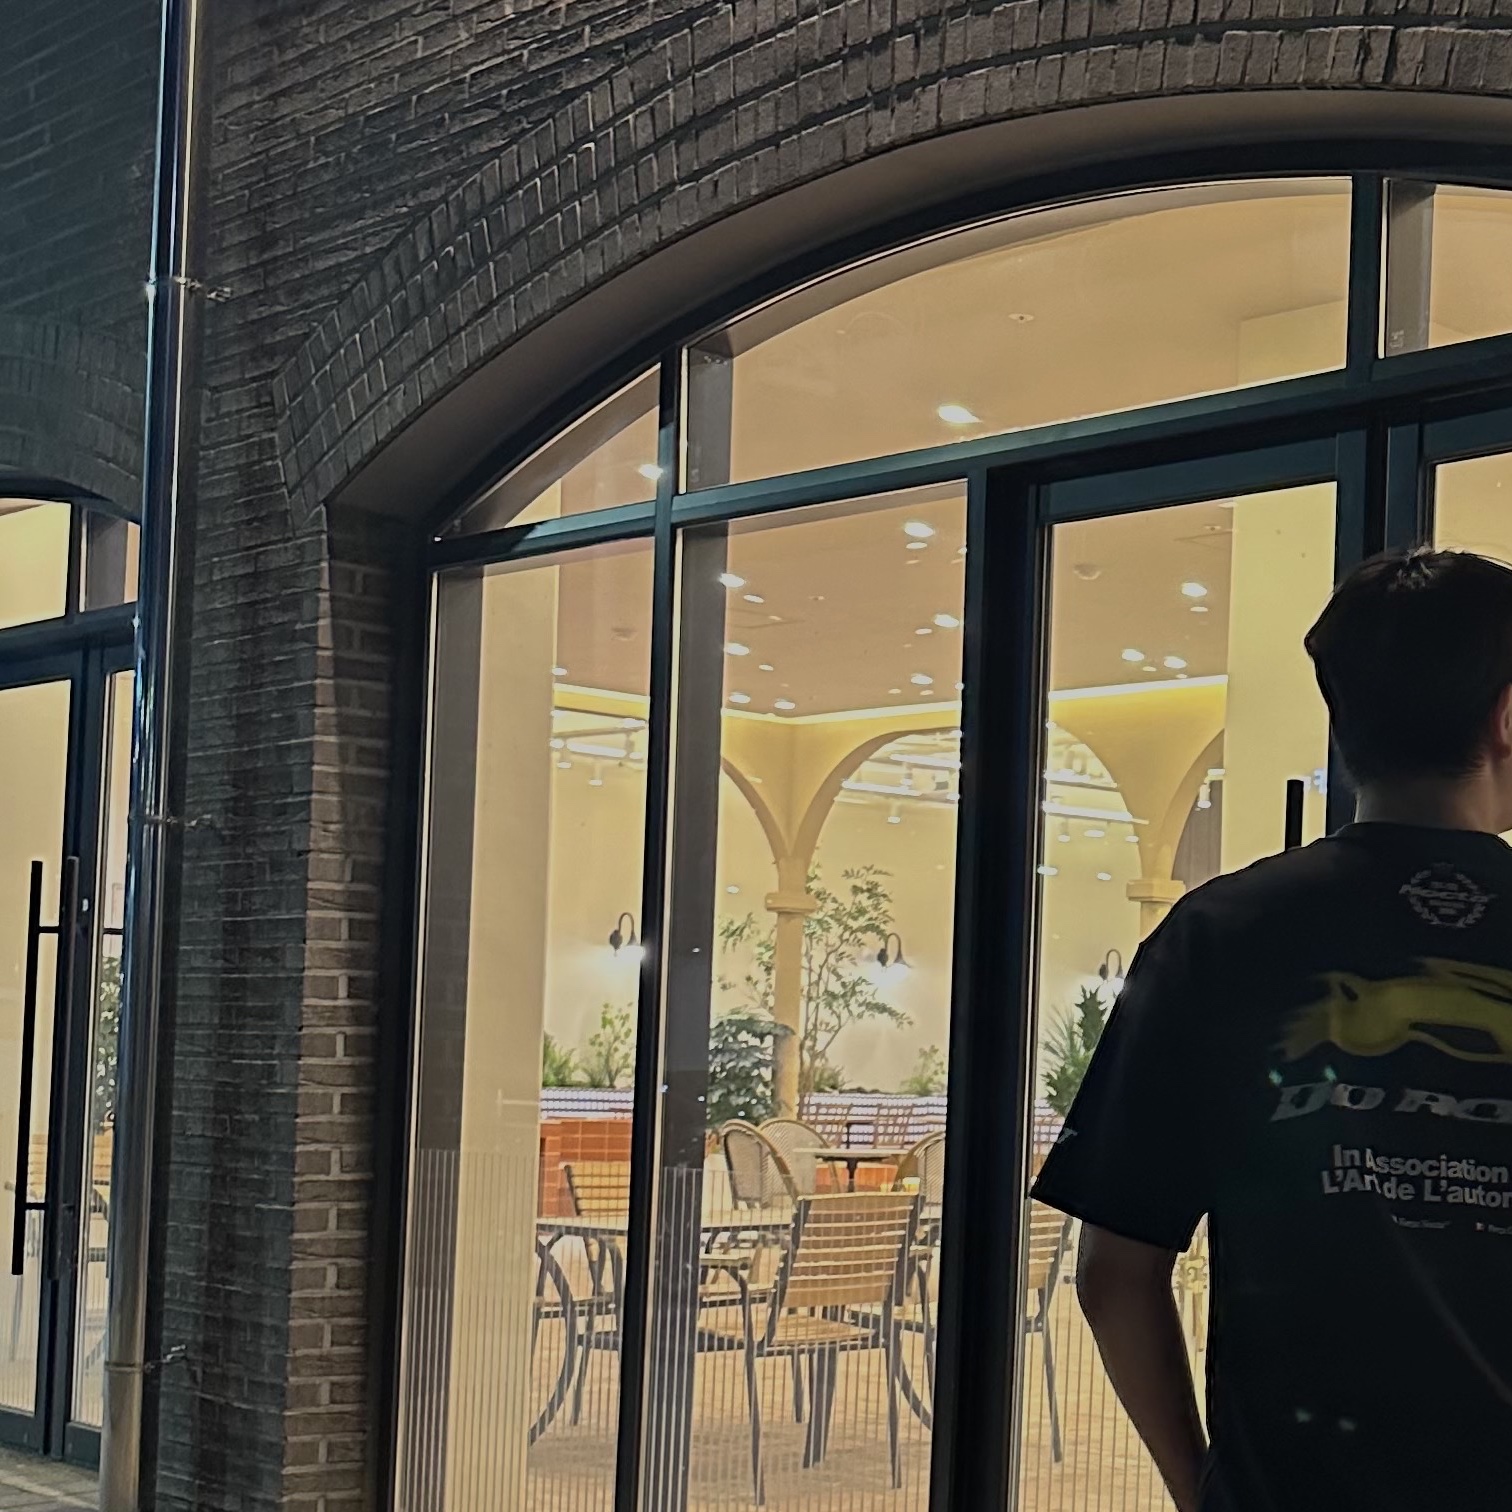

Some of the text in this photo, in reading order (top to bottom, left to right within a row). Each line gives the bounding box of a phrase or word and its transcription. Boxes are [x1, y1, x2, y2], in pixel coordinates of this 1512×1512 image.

[1332, 1143, 1361, 1168] In
[1365, 1148, 1509, 1184] Association
[1382, 1176, 1416, 1201] de
